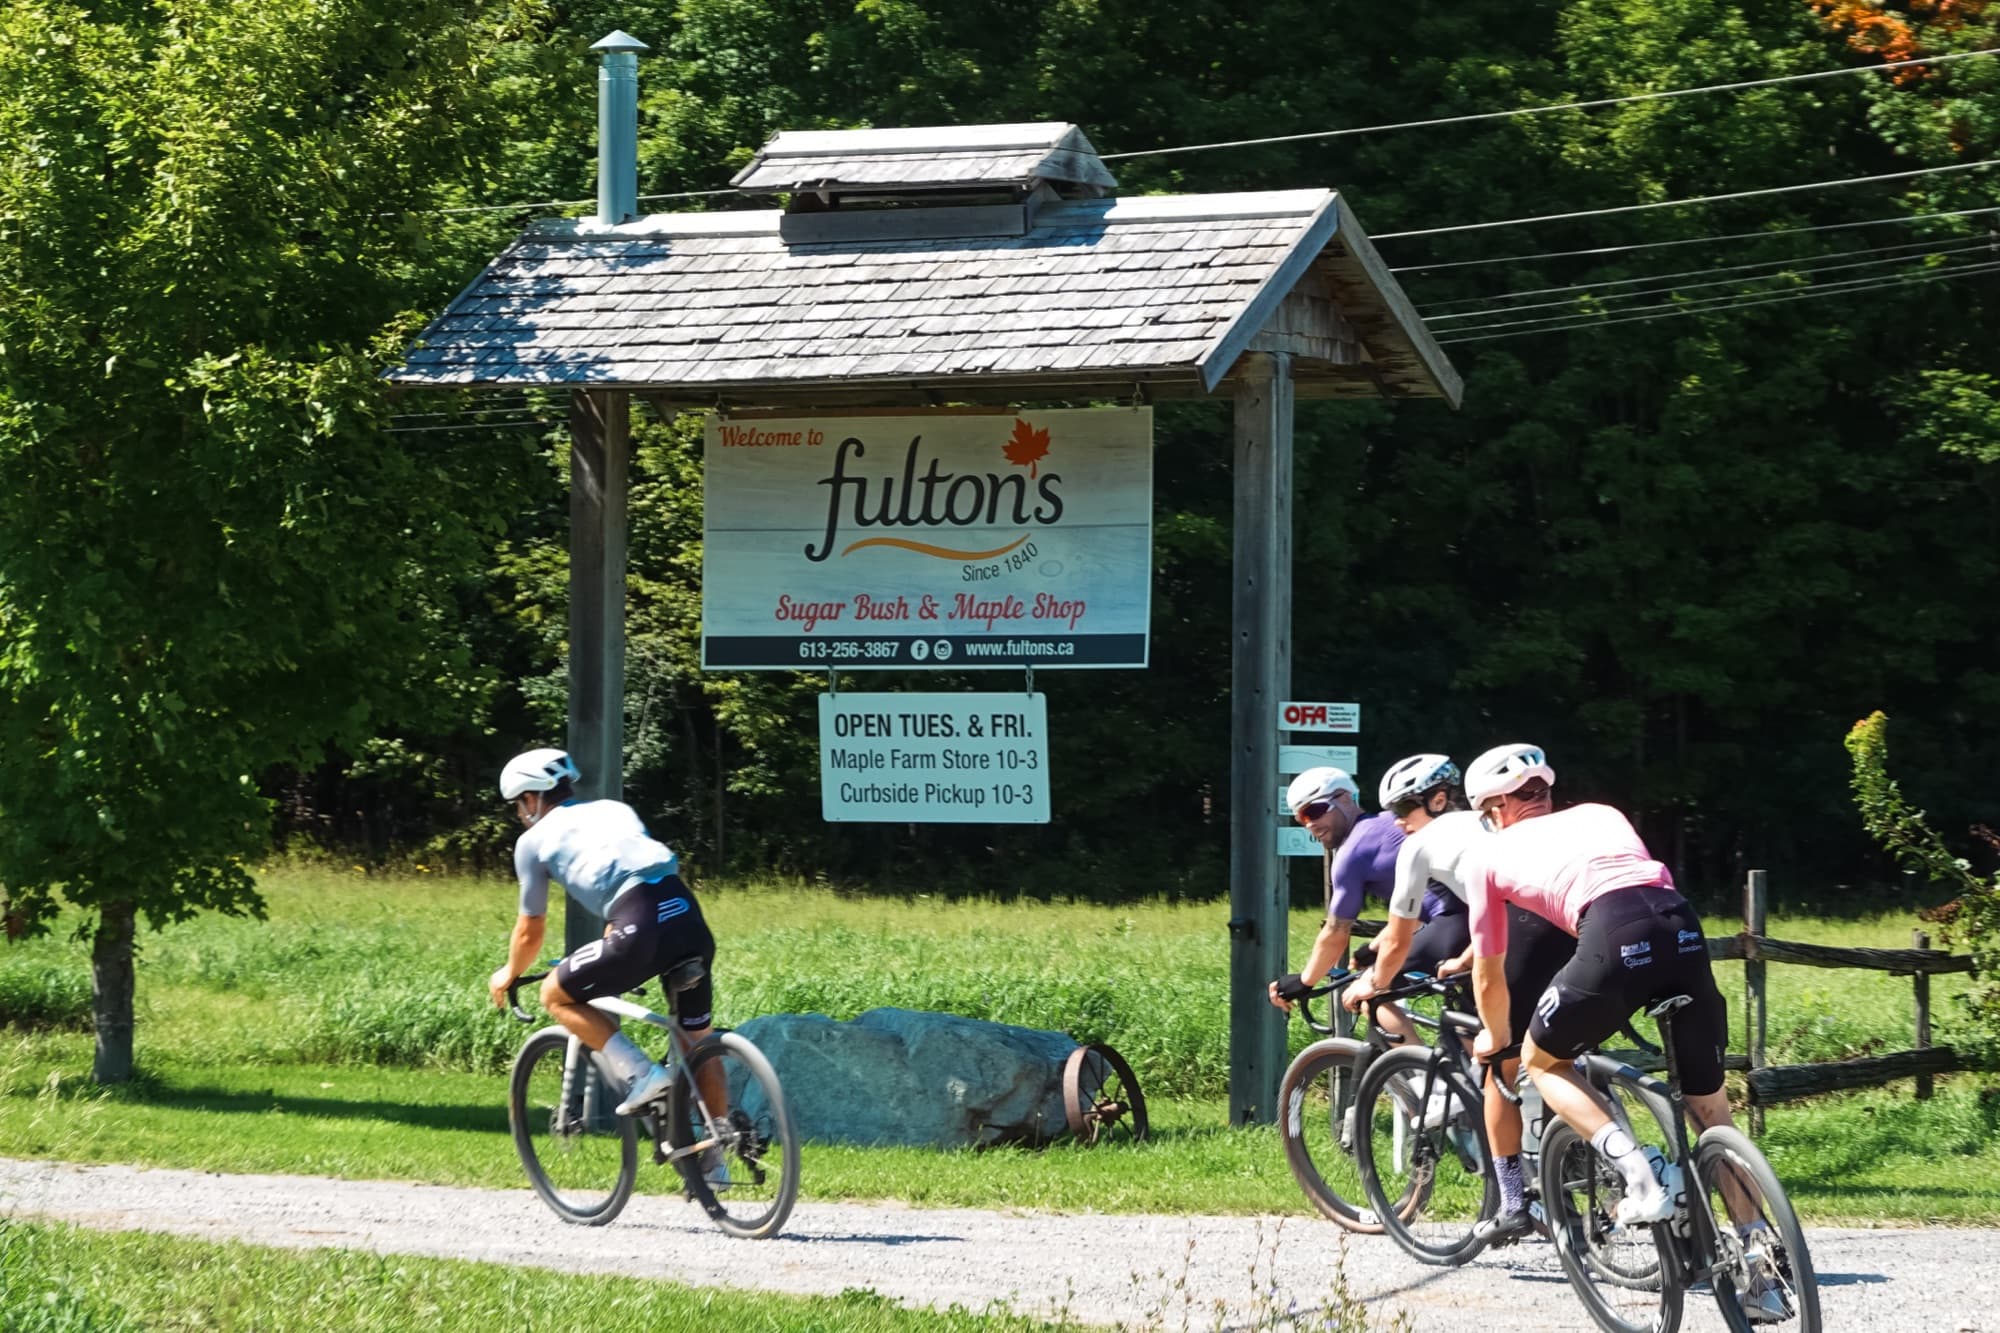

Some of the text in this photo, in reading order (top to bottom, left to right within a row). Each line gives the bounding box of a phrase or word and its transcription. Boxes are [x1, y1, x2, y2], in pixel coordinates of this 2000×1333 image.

[718, 426, 824, 447] Welcome to
[962, 542, 1038, 581] Since 1840
[775, 592, 1086, 632] Sugar Bush & Maple Shop
[799, 642, 899, 658] 613-256-3867
[965, 640, 1074, 656] www.fultons.ca
[834, 713, 1032, 738] OPEN TUES. & FRI.
[1284, 705, 1327, 726] OFA
[830, 749, 1038, 773] Maple Farm Store 10-3
[840, 783, 1033, 808] Curbside Pickup 10-3
